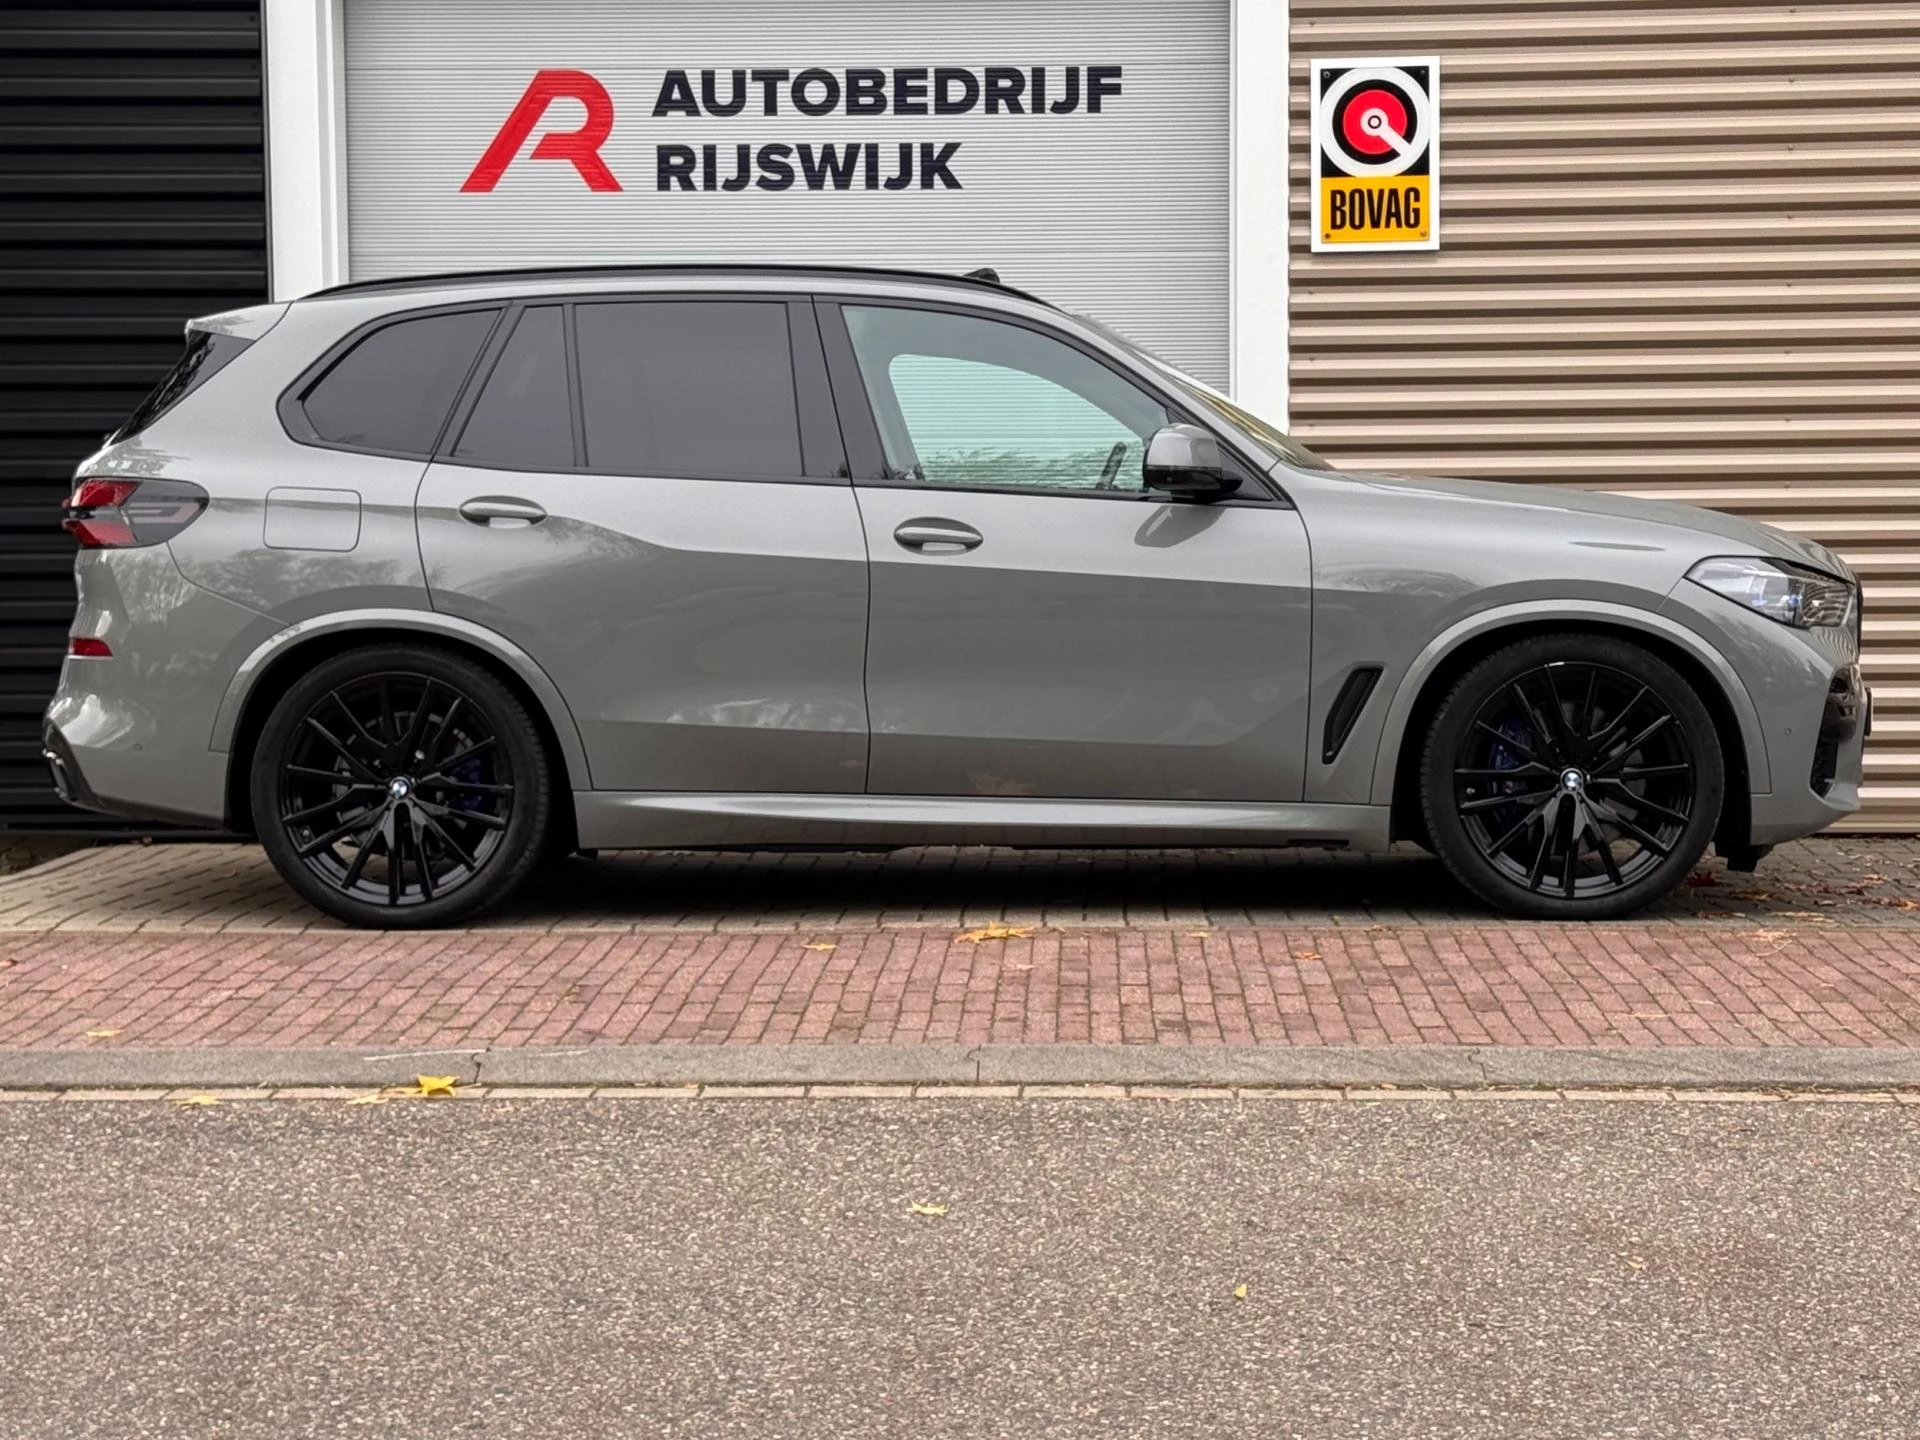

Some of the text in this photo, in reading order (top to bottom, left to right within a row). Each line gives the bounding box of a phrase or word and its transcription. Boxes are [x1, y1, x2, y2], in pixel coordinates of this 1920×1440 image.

[652, 66, 1123, 118] AUTOBEDRIJF
[656, 143, 963, 193] RIJSWIJK
[1330, 187, 1420, 230] BOVAG
